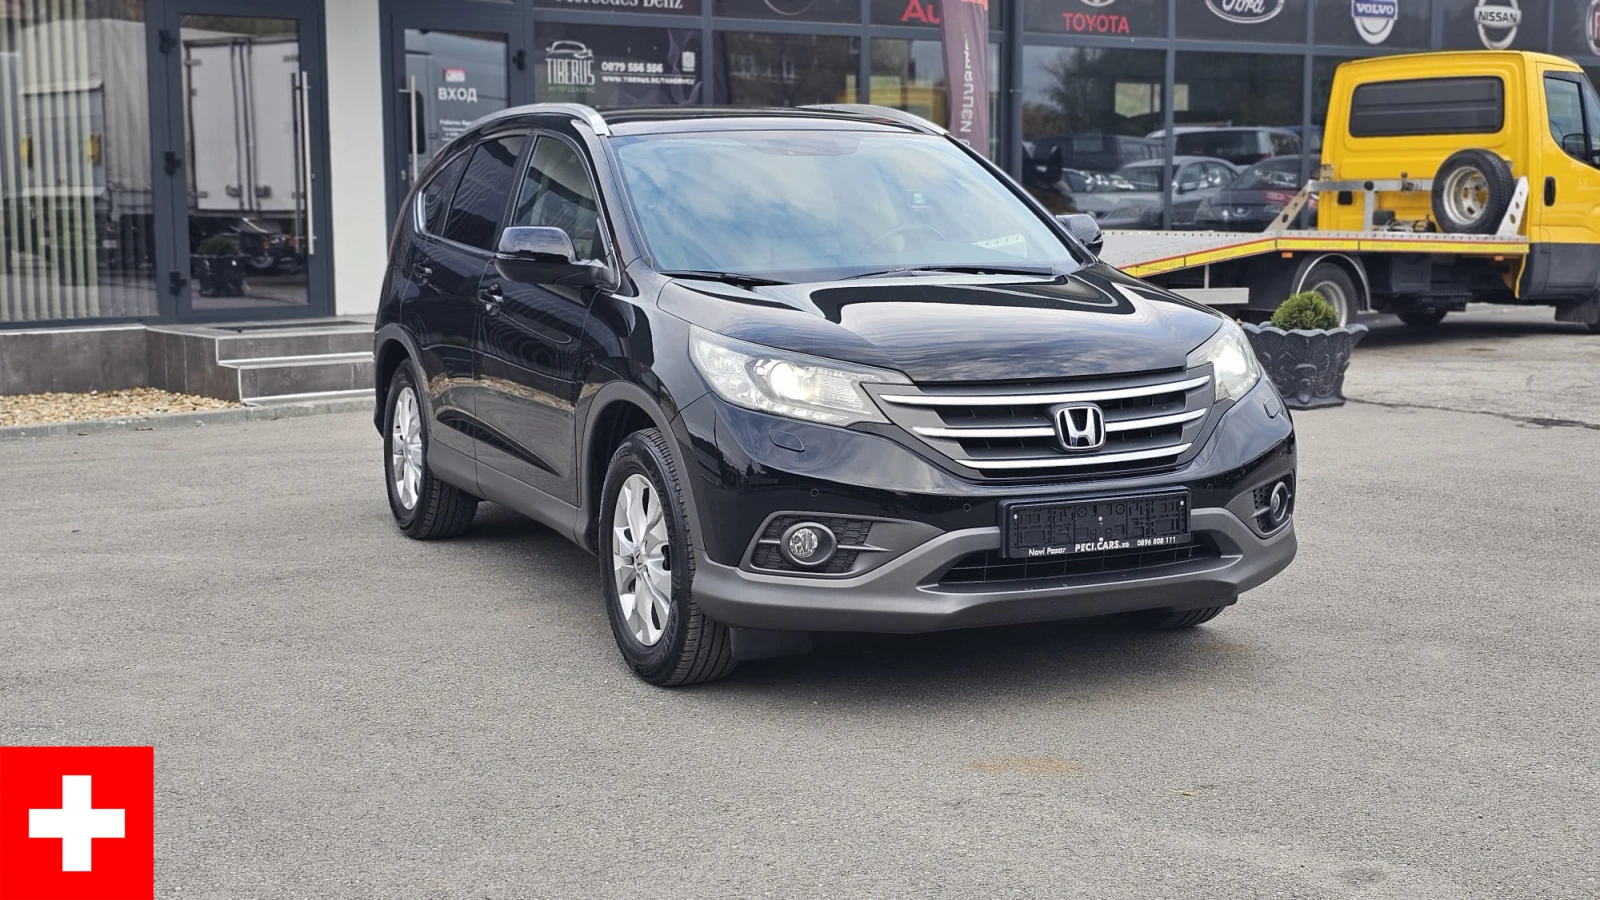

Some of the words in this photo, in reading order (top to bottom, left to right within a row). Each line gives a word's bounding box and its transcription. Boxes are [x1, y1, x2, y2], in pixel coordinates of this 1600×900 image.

[643, 0, 683, 9] Benz
[1222, 0, 1266, 13] Ford
[1356, 3, 1394, 15] VOLVO
[901, 0, 941, 24] Au
[1478, 10, 1517, 23] NISSAN
[1062, 12, 1130, 34] TOYOTA
[545, 58, 596, 86] TIBERUS
[601, 61, 626, 72] 0879
[627, 62, 645, 73] 556
[646, 63, 664, 73] 556
[437, 87, 478, 103] ВХОД
[1137, 538, 1152, 547] 0896
[1153, 537, 1164, 545] 808
[1165, 536, 1176, 544] 111
